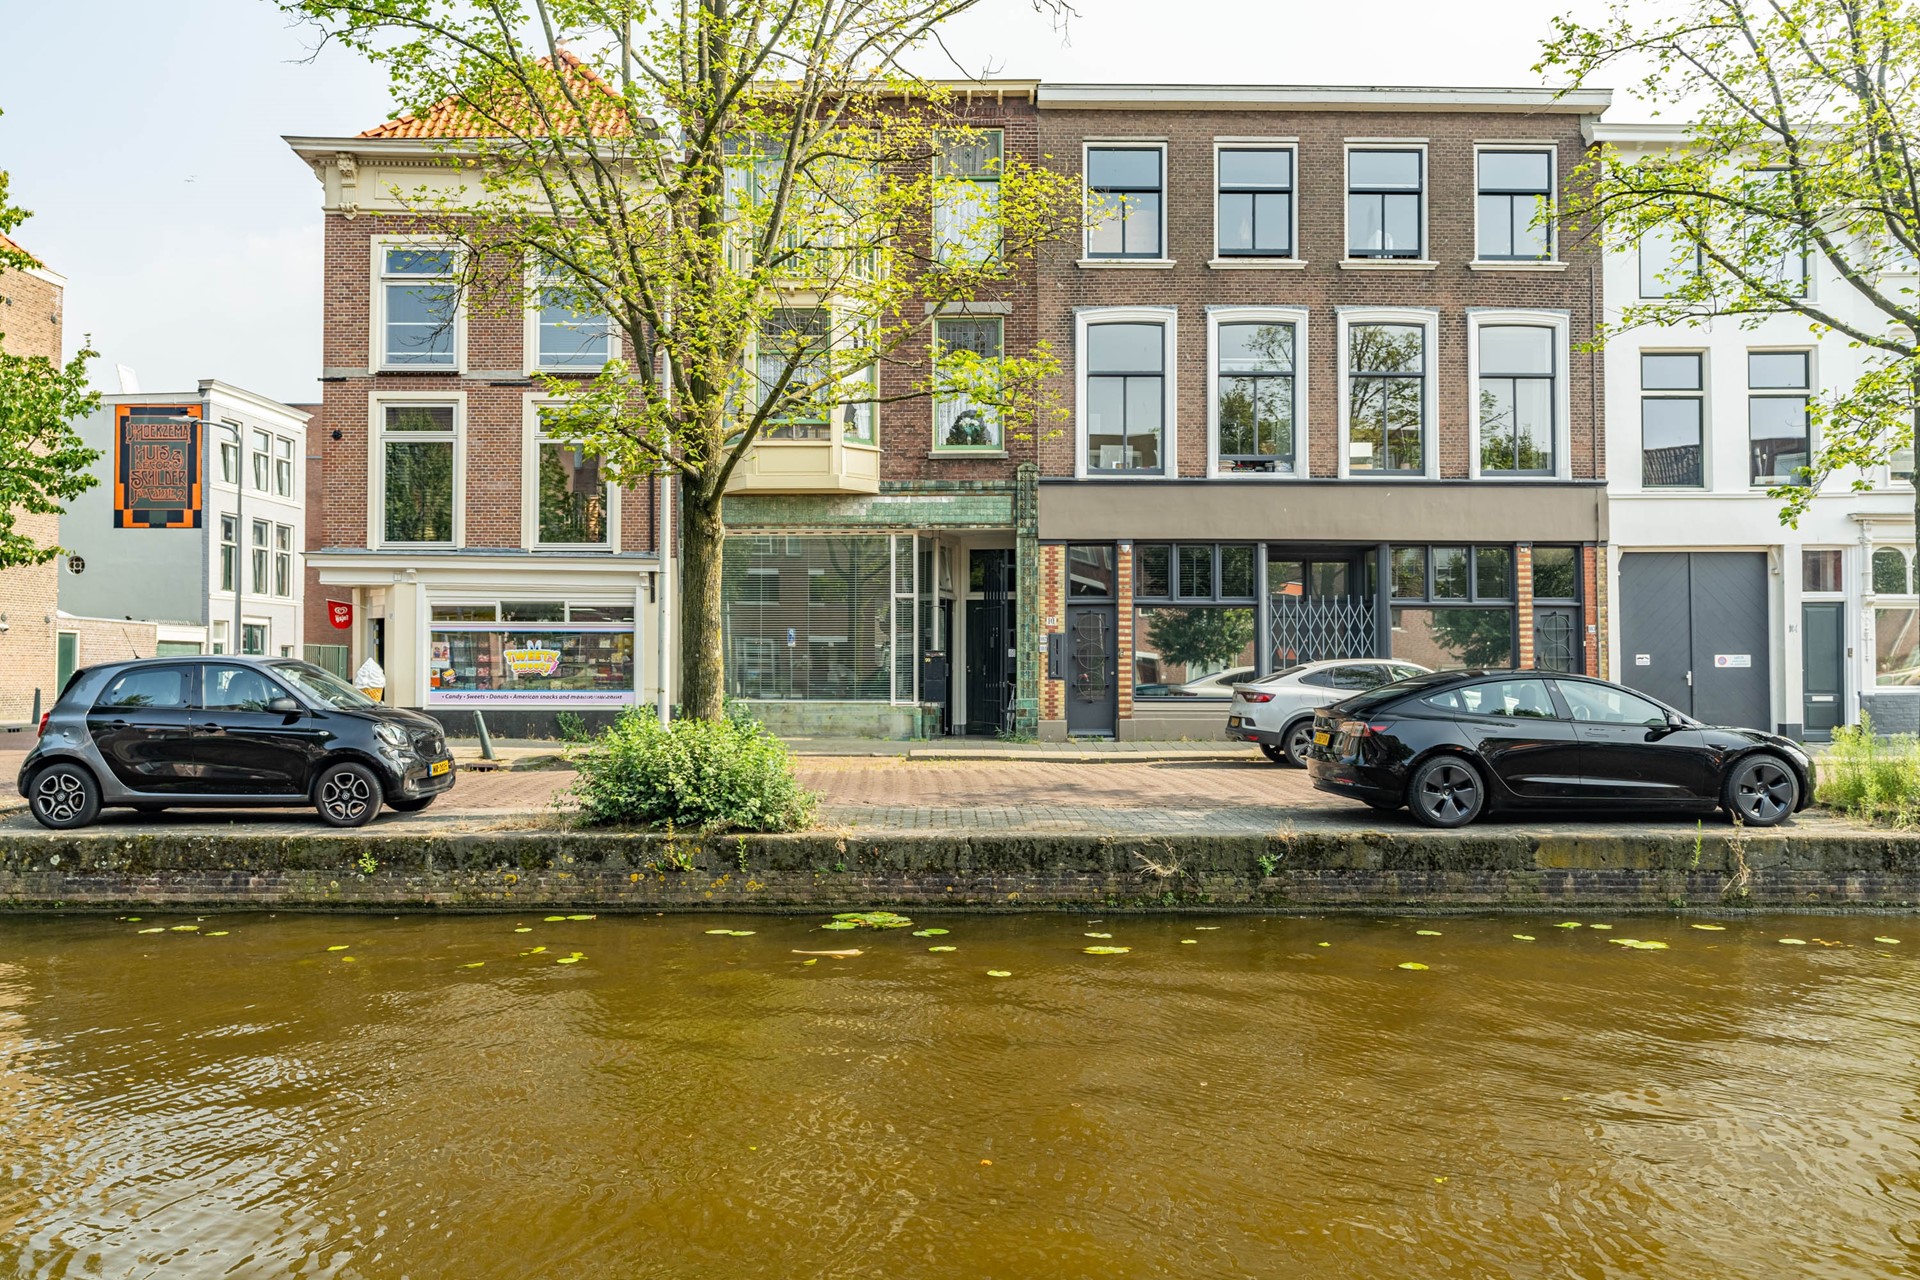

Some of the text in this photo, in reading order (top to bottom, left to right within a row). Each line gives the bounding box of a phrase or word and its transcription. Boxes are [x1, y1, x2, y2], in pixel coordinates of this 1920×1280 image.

[135, 445, 169, 460] HUIS
[131, 471, 186, 489] SCHILDER
[176, 489, 185, 500] 2
[505, 650, 559, 662] TWEETY
